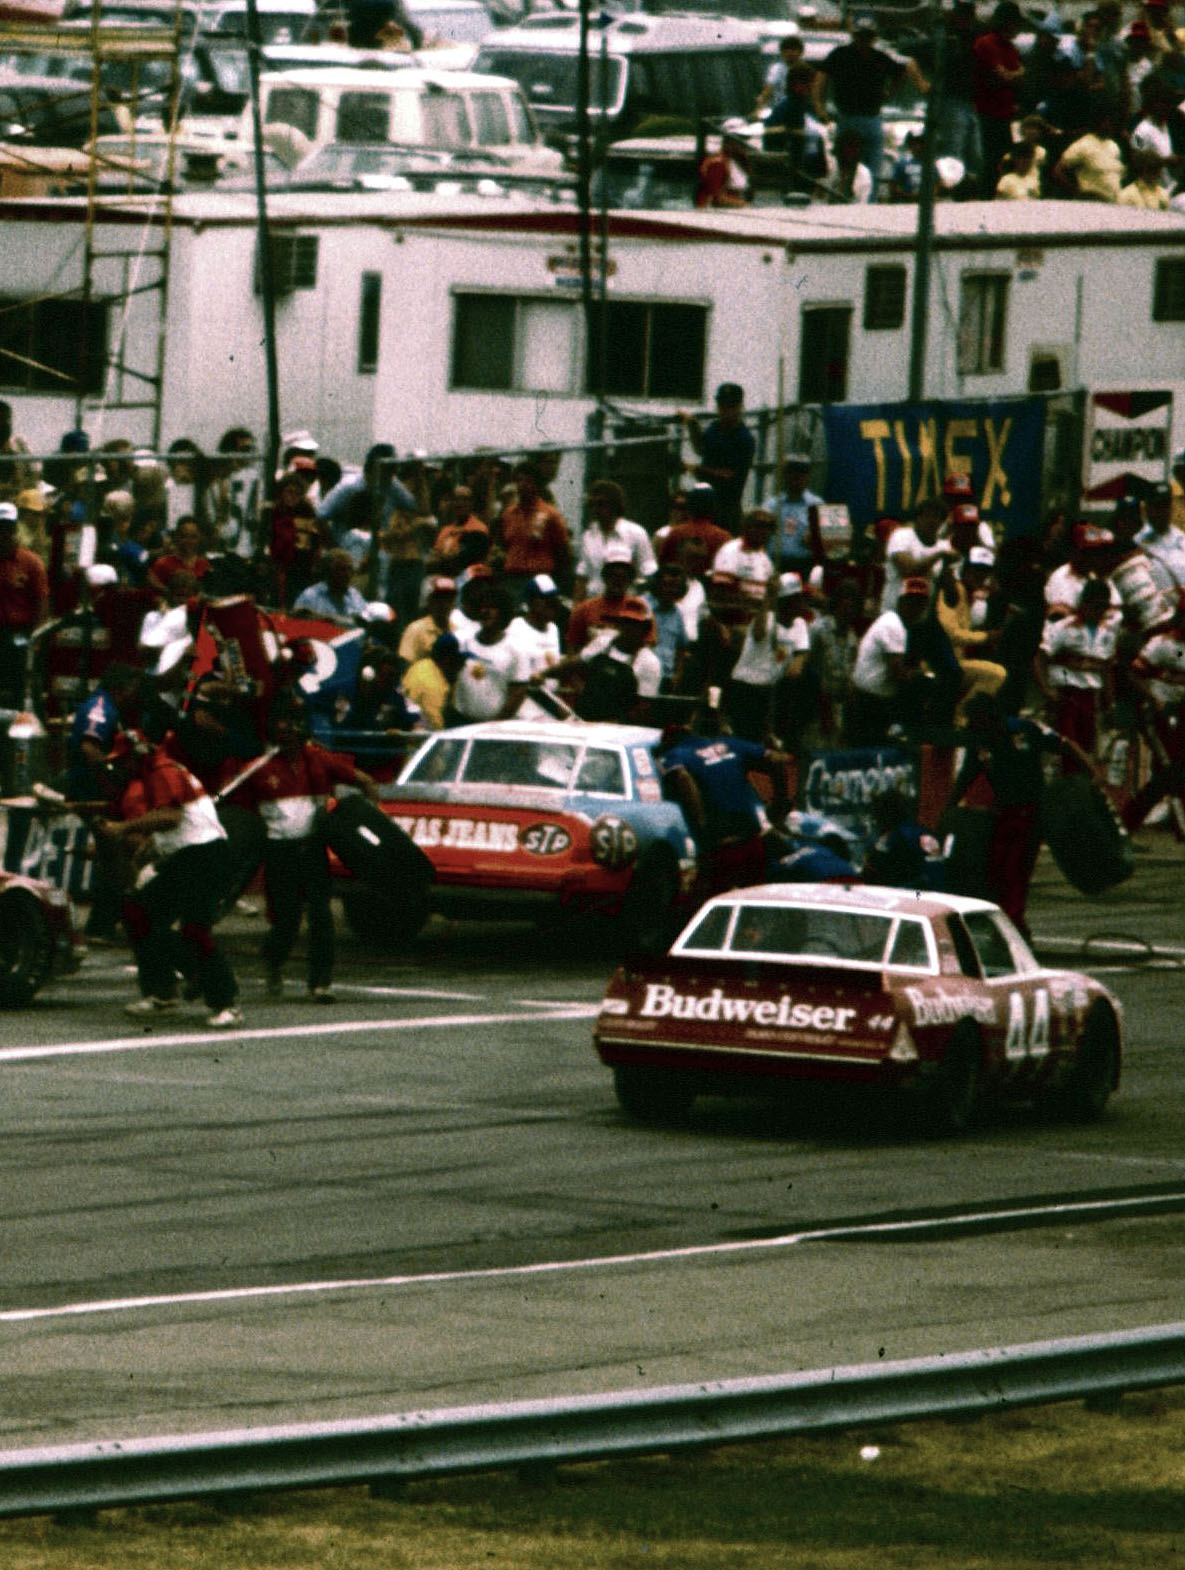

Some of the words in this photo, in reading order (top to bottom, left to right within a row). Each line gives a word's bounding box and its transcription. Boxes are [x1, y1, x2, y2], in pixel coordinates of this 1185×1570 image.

[443, 819, 519, 853] JEANS
[526, 826, 570, 853] STP
[596, 817, 637, 862] STP
[640, 984, 857, 1031] Budweiser
